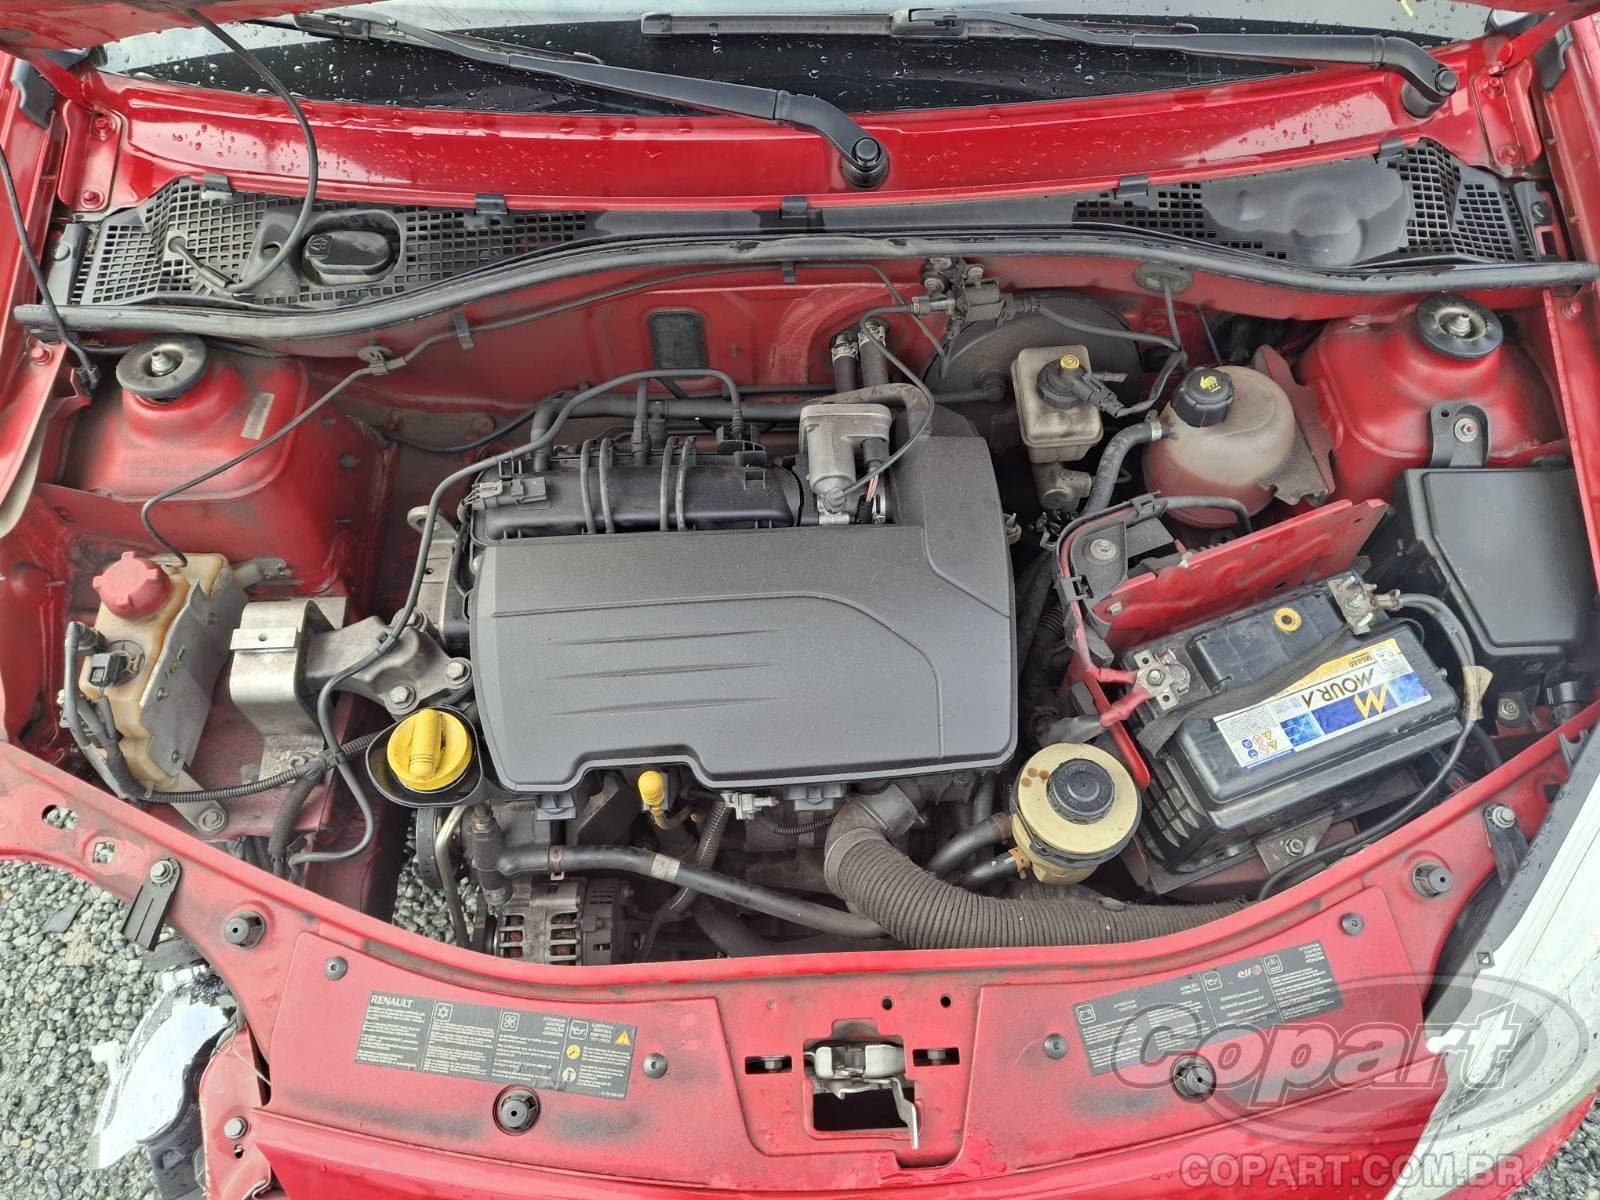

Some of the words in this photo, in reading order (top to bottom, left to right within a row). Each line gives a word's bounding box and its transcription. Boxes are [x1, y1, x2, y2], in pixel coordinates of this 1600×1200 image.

[1301, 668, 1374, 708] MOURA
[1237, 967, 1253, 978] elf
[371, 994, 414, 1008] RENAULT
